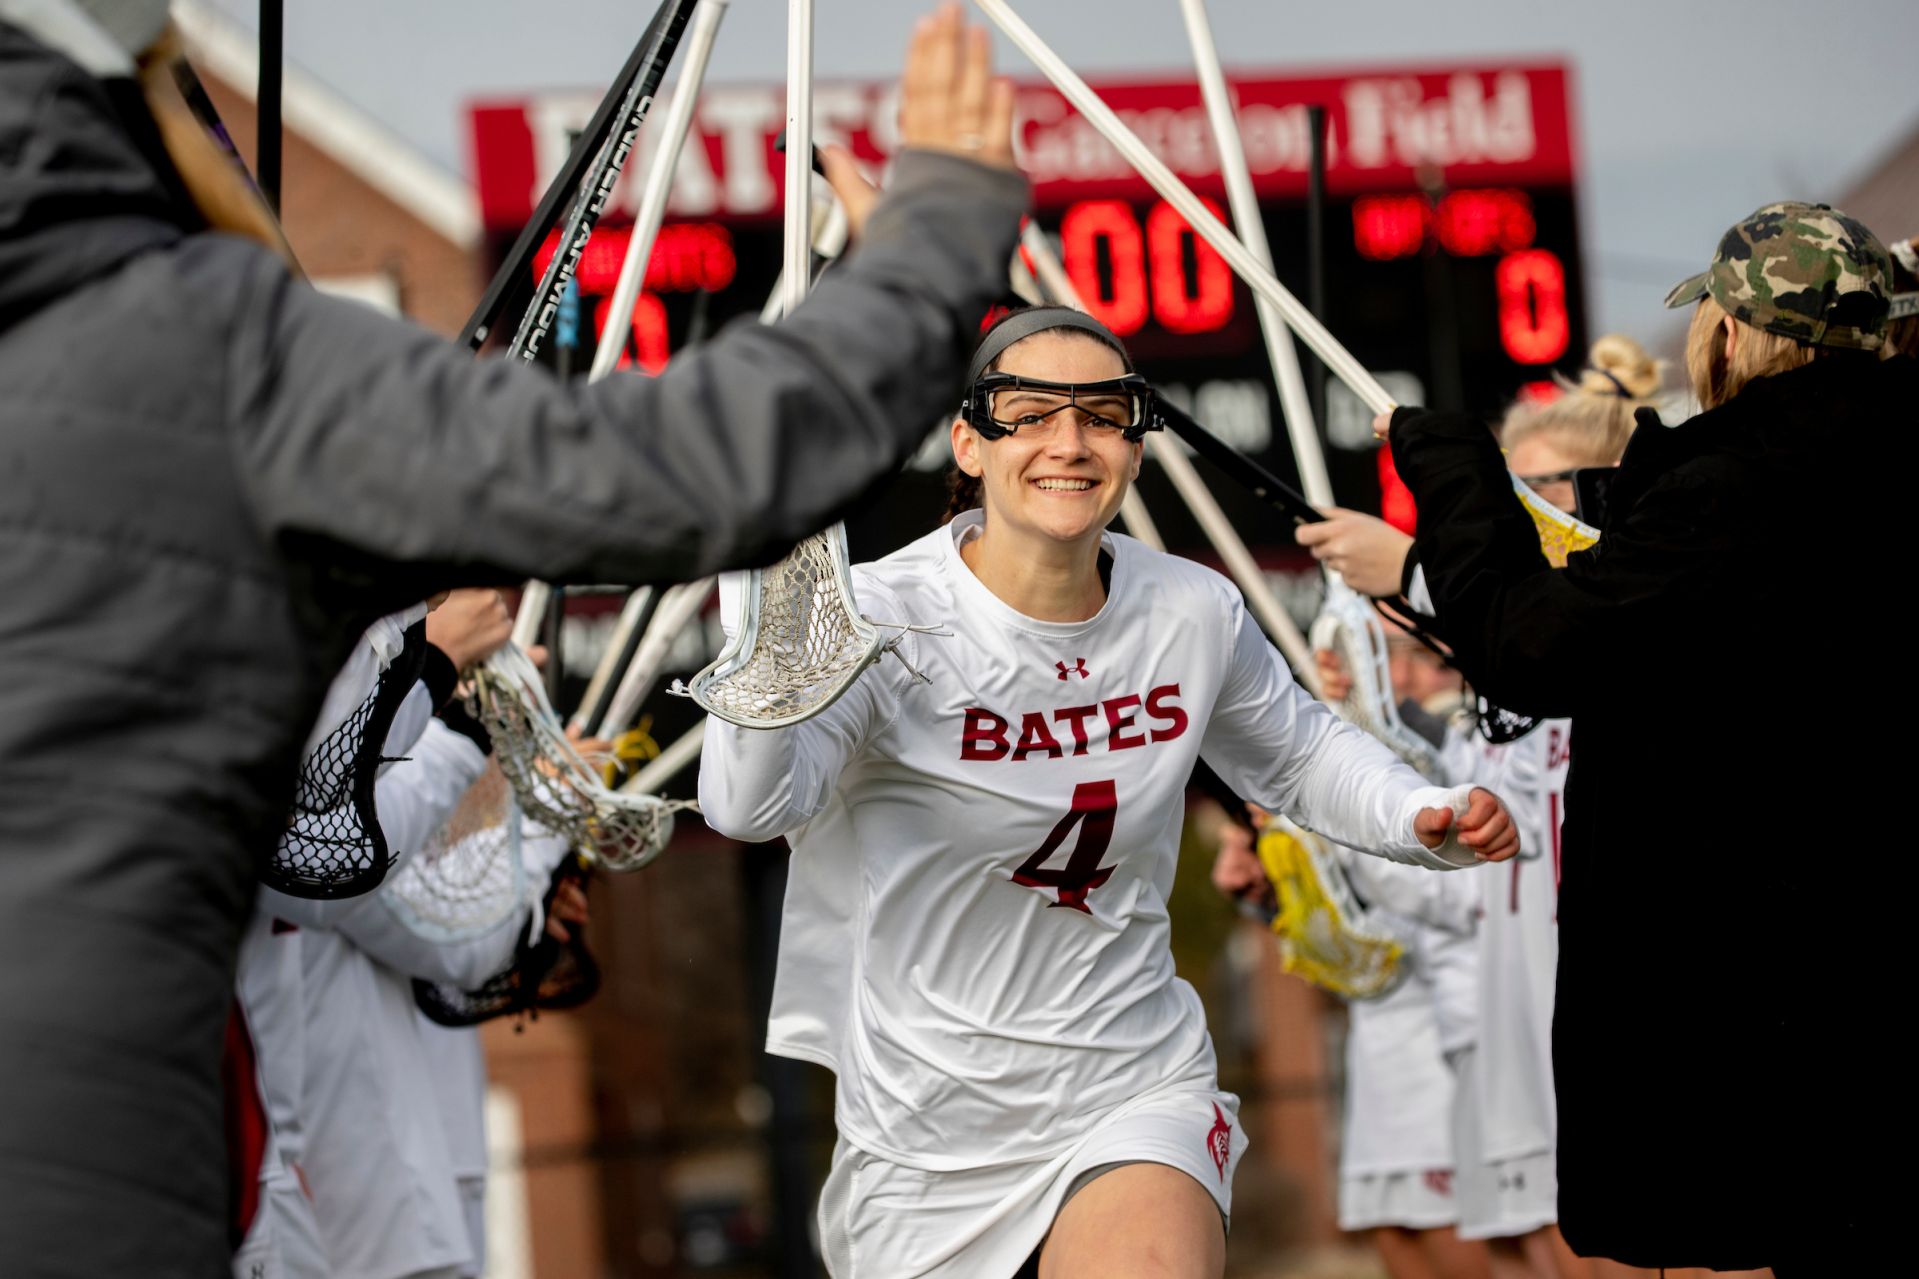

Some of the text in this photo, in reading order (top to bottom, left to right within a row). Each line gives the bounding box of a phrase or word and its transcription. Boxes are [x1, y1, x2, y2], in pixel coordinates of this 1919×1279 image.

[1341, 70, 1537, 168] Field
[523, 95, 653, 362] UNDER ARMOU
[1061, 197, 1234, 336] 00
[1496, 248, 1570, 364] 0
[959, 683, 1188, 762] BATES
[1007, 779, 1118, 915] 4
